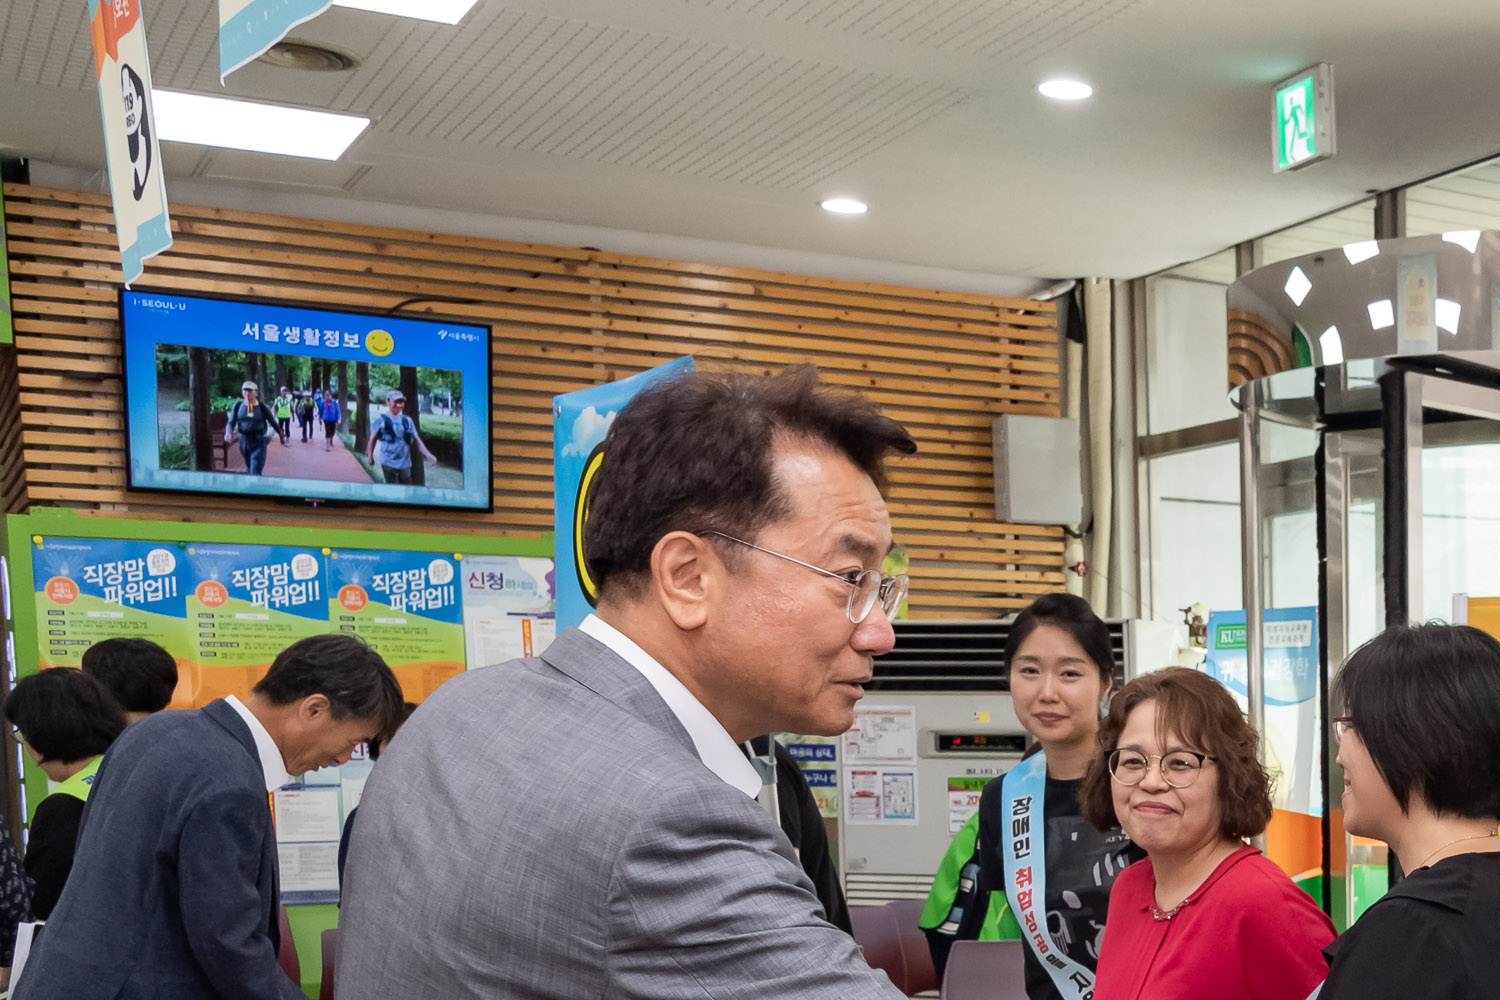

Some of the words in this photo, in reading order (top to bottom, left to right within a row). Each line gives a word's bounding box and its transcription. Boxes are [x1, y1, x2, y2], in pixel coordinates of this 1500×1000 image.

[241, 321, 361, 350] 서울생활정보
[83, 557, 145, 586] 직장맘
[231, 562, 291, 591] 직장맘
[372, 568, 428, 594] 직장맘
[102, 576, 177, 606] 파워업!!
[250, 581, 321, 610] 파워업!!
[389, 585, 455, 614] 파워업!!
[1012, 796, 1032, 860] 장애인
